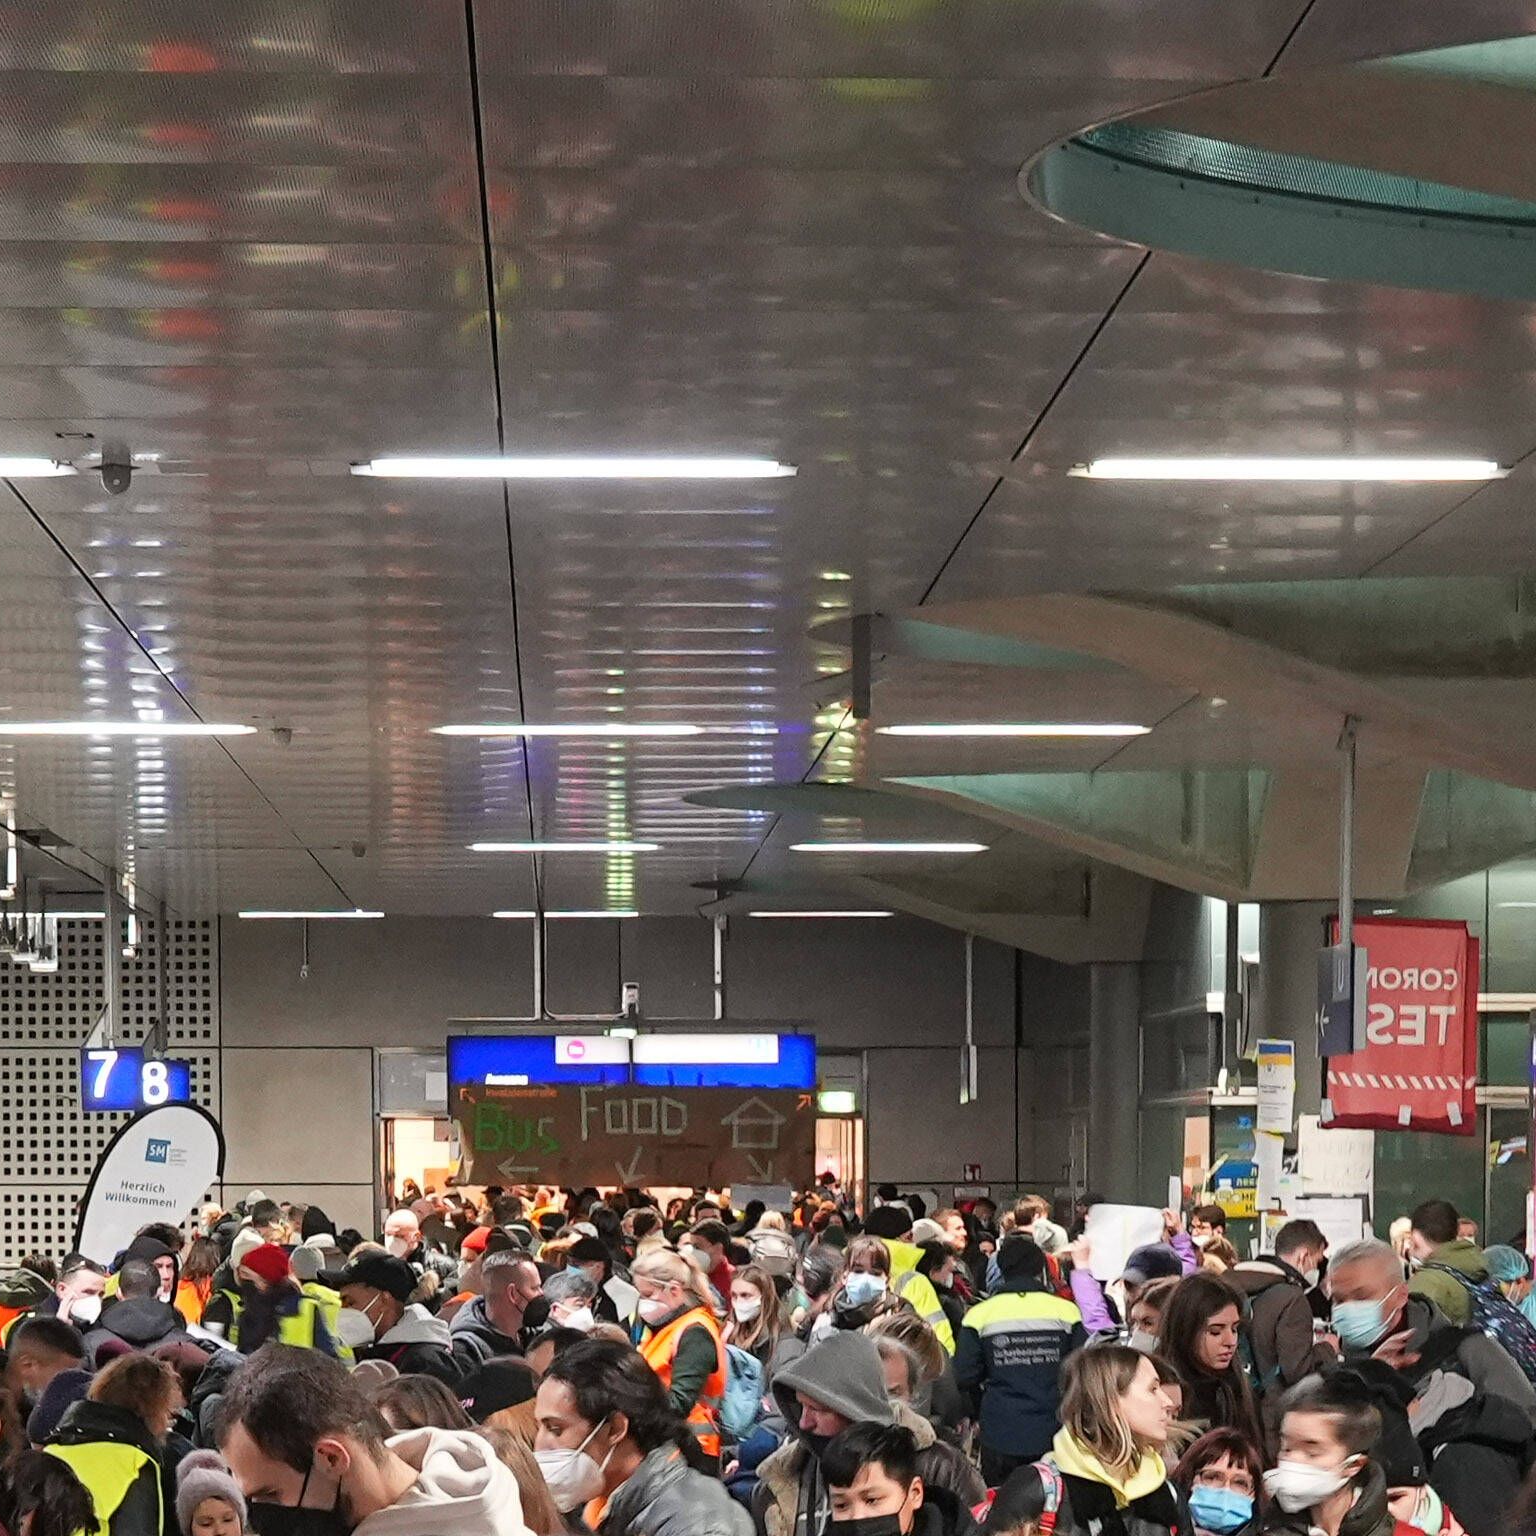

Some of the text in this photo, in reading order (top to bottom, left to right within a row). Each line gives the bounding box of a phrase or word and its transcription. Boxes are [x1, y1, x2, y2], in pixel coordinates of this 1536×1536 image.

[88, 1052, 118, 1098] 7
[142, 1062, 169, 1105] 8
[105, 1192, 177, 1208] Willkommen!
[120, 1180, 165, 1193] Herzlich
